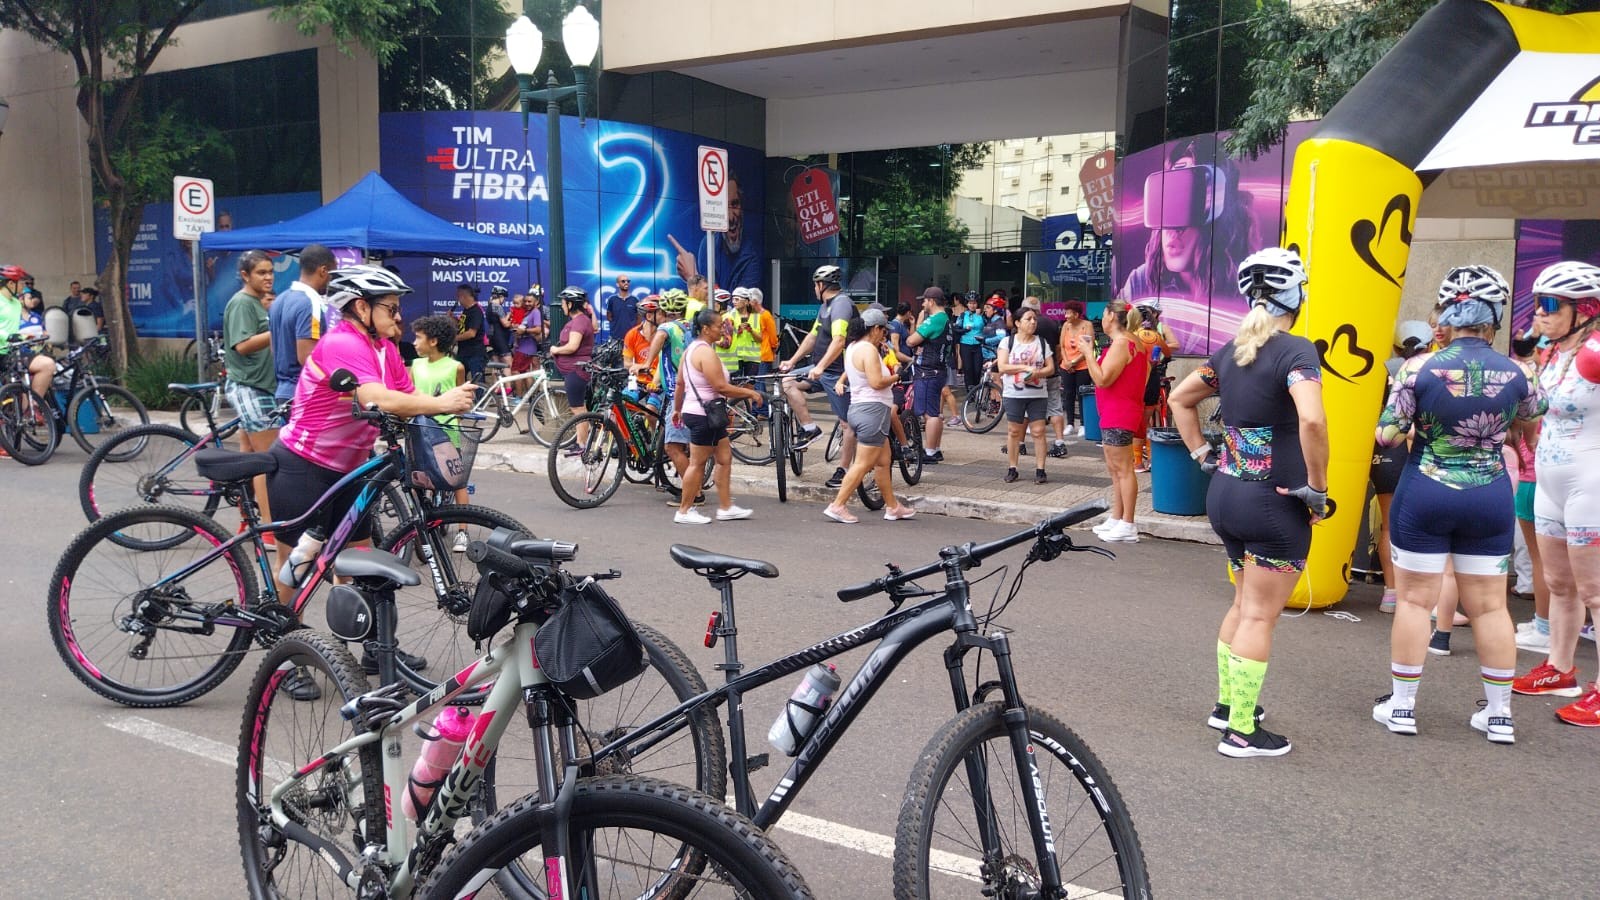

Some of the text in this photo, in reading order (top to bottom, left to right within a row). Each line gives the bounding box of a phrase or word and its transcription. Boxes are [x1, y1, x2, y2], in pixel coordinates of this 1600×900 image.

[452, 126, 492, 145] TIM
[453, 147, 536, 172] ULTRA
[452, 172, 549, 201] FIBRA
[189, 188, 202, 207] E
[796, 189, 820, 208] ETI
[1090, 189, 1114, 208] QU
[800, 200, 829, 220] QUE
[499, 223, 545, 236] BANDA
[802, 218, 821, 232] TA
[478, 257, 521, 267] AINDA
[432, 270, 510, 283] MAIS VELOZ.
[130, 283, 152, 300] TIM
[795, 654, 882, 776] ABSOLUTE
[1392, 710, 1409, 718] JUST
[1488, 718, 1504, 726] JUST
[1028, 762, 1057, 854] ABSOLUTE
